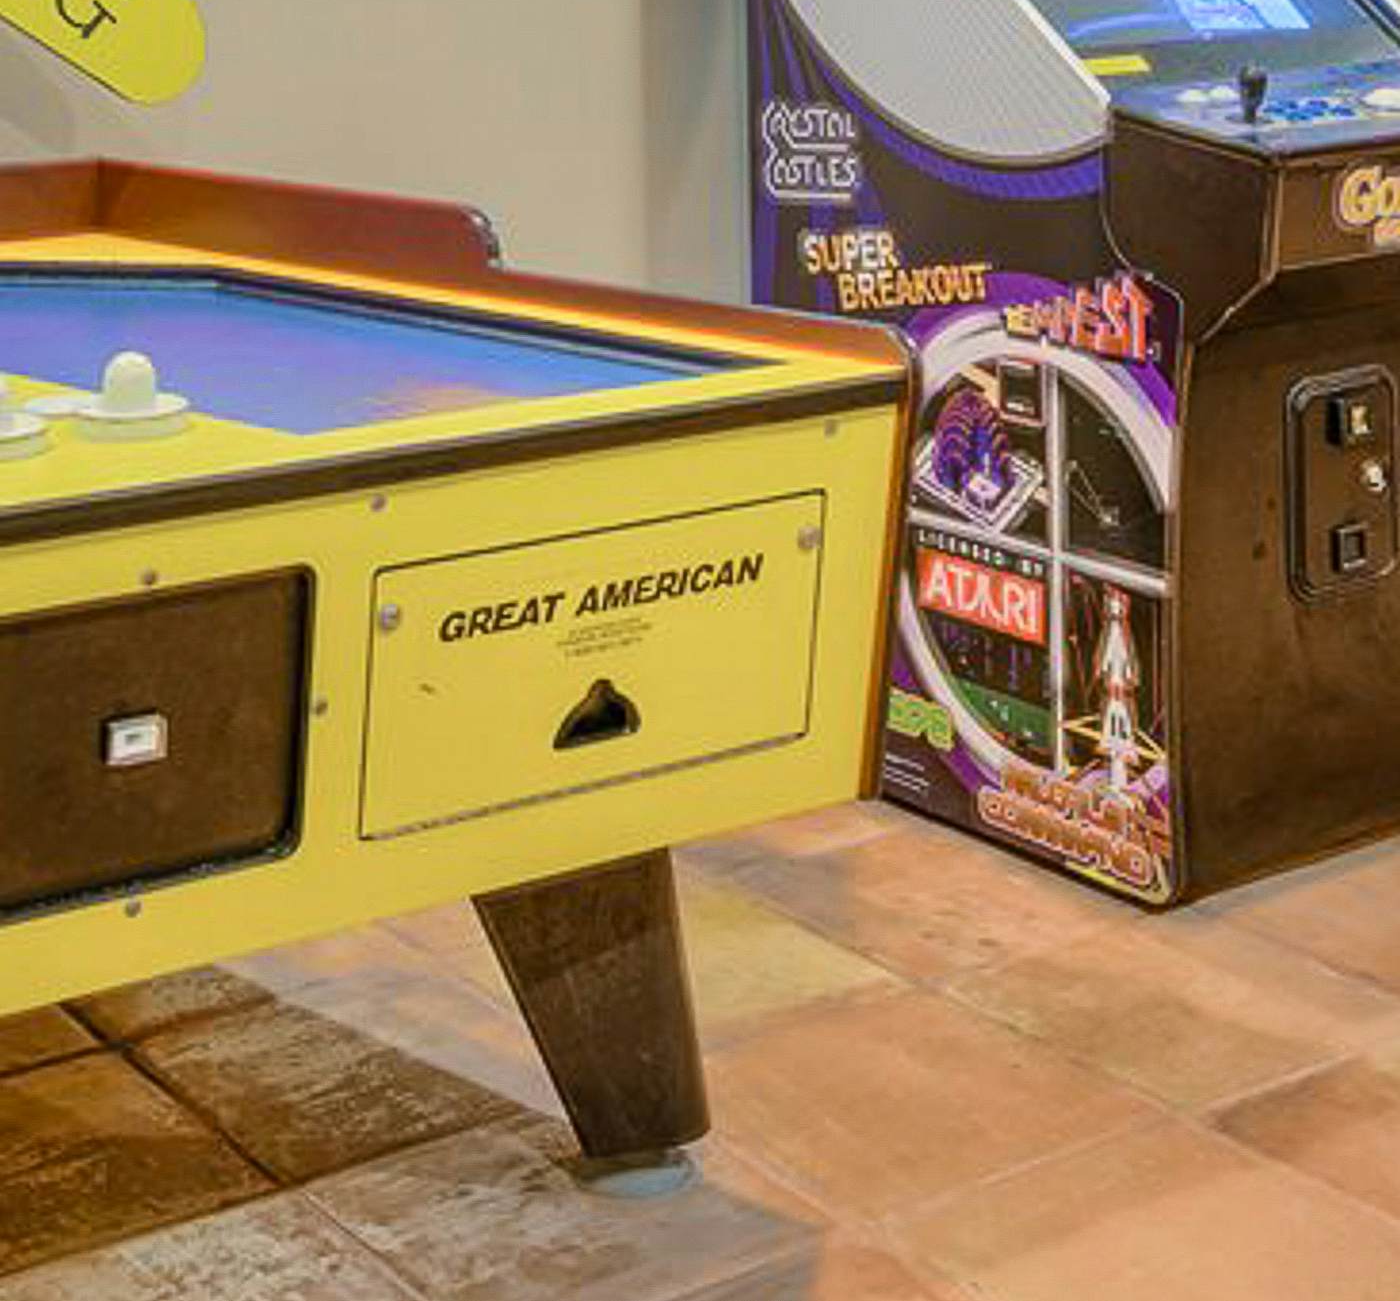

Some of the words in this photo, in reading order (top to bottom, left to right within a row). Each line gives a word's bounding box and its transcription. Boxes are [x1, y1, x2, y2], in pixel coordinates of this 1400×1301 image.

[803, 233, 898, 275] SUPER
[838, 264, 988, 311] BREAKOUT
[438, 592, 566, 642] GREAT
[575, 553, 764, 617] AMERICAN
[925, 556, 1038, 634] ATARI
